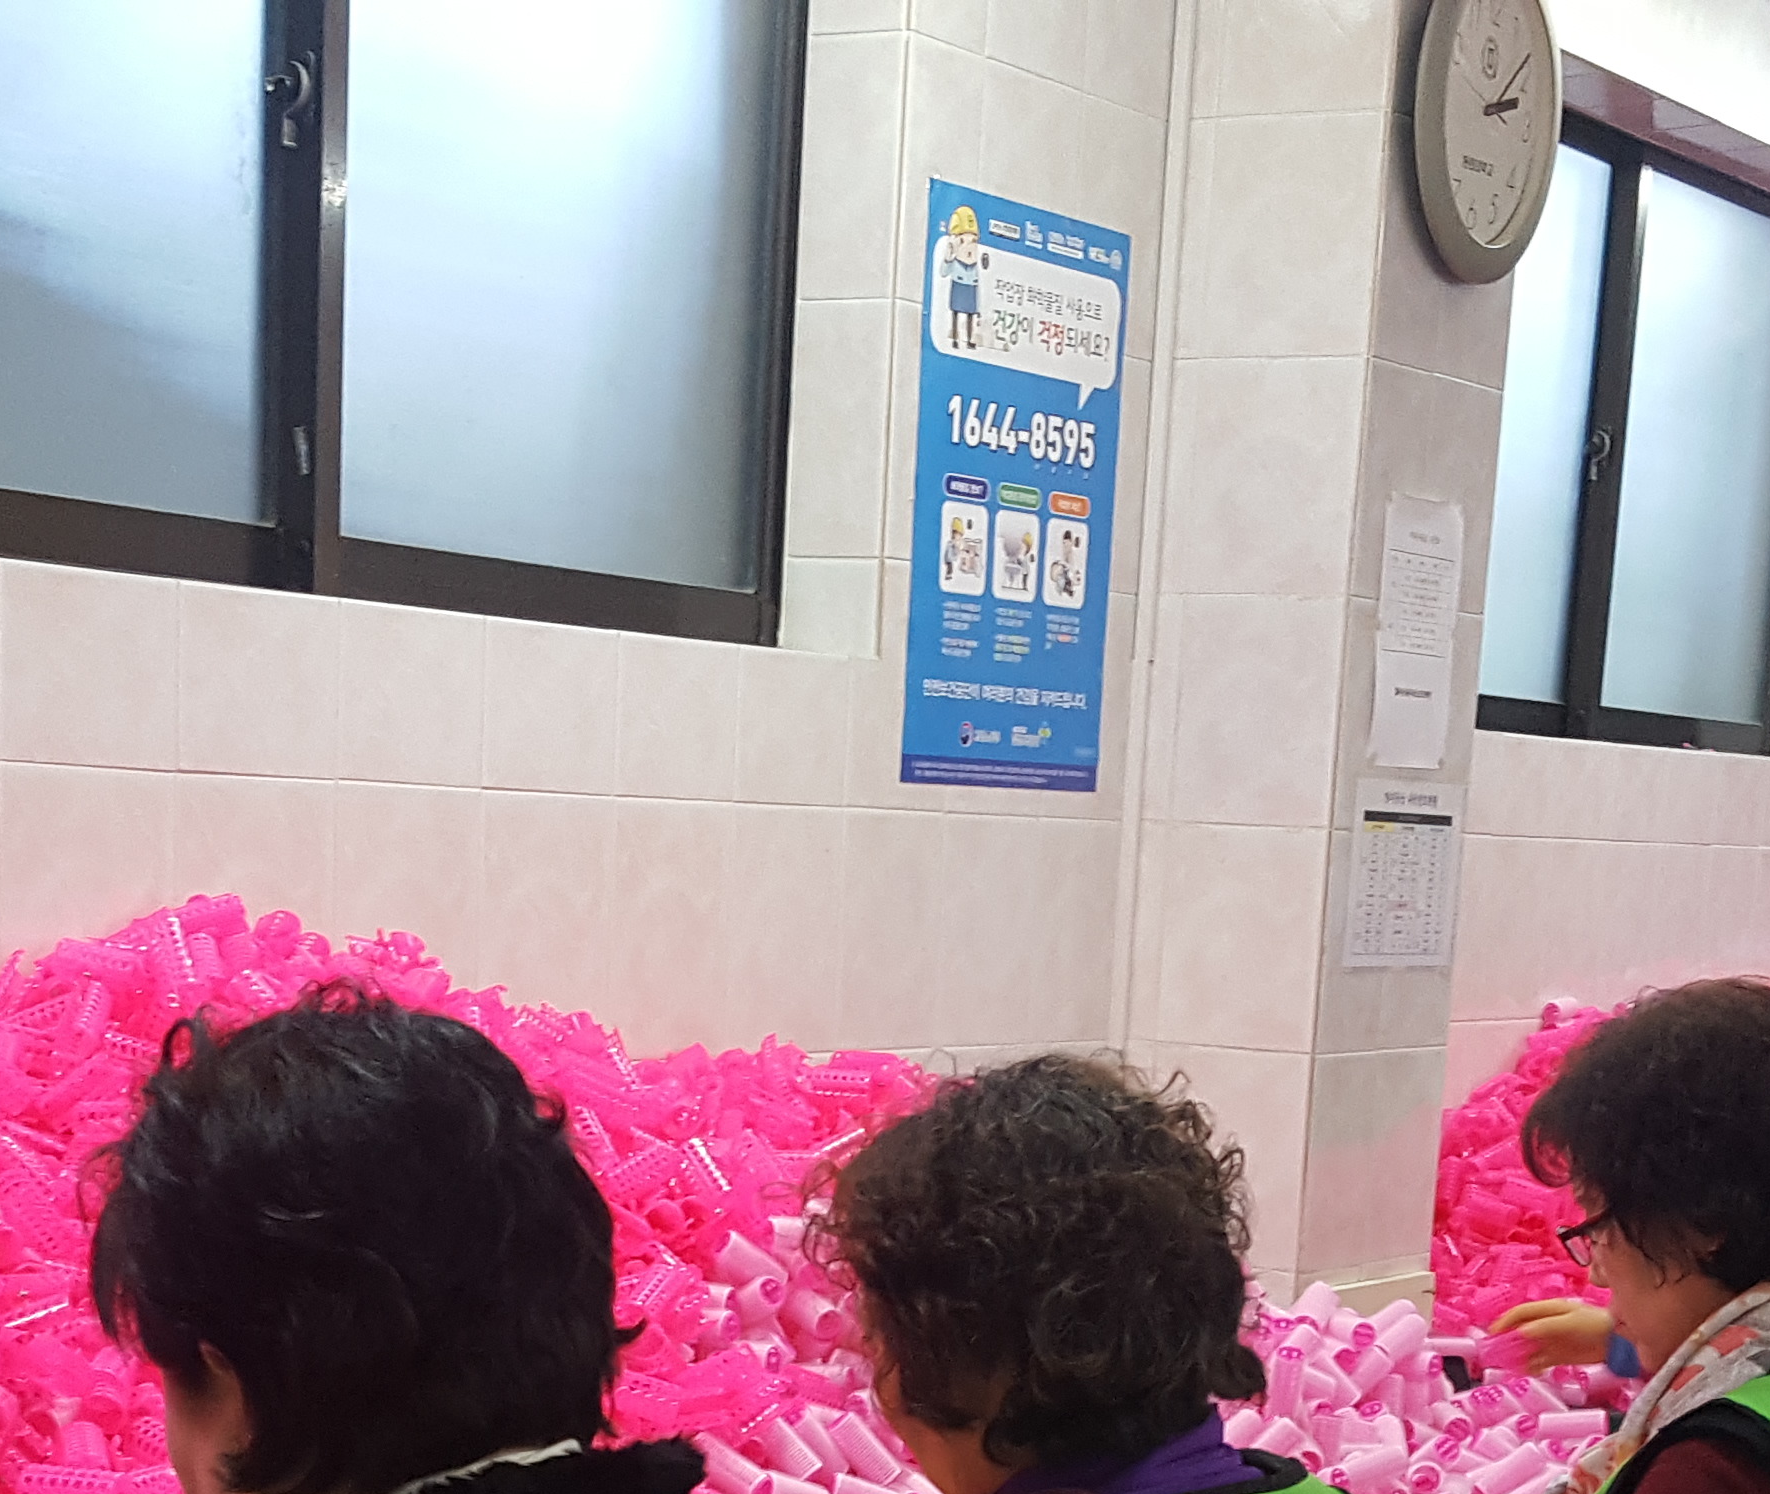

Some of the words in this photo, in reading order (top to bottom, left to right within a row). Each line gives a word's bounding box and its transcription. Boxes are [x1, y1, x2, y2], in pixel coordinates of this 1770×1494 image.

[993, 309, 1034, 346] 건강이
[1037, 320, 1111, 362] 걱정되세요?
[947, 394, 1097, 470] 1644-8595
